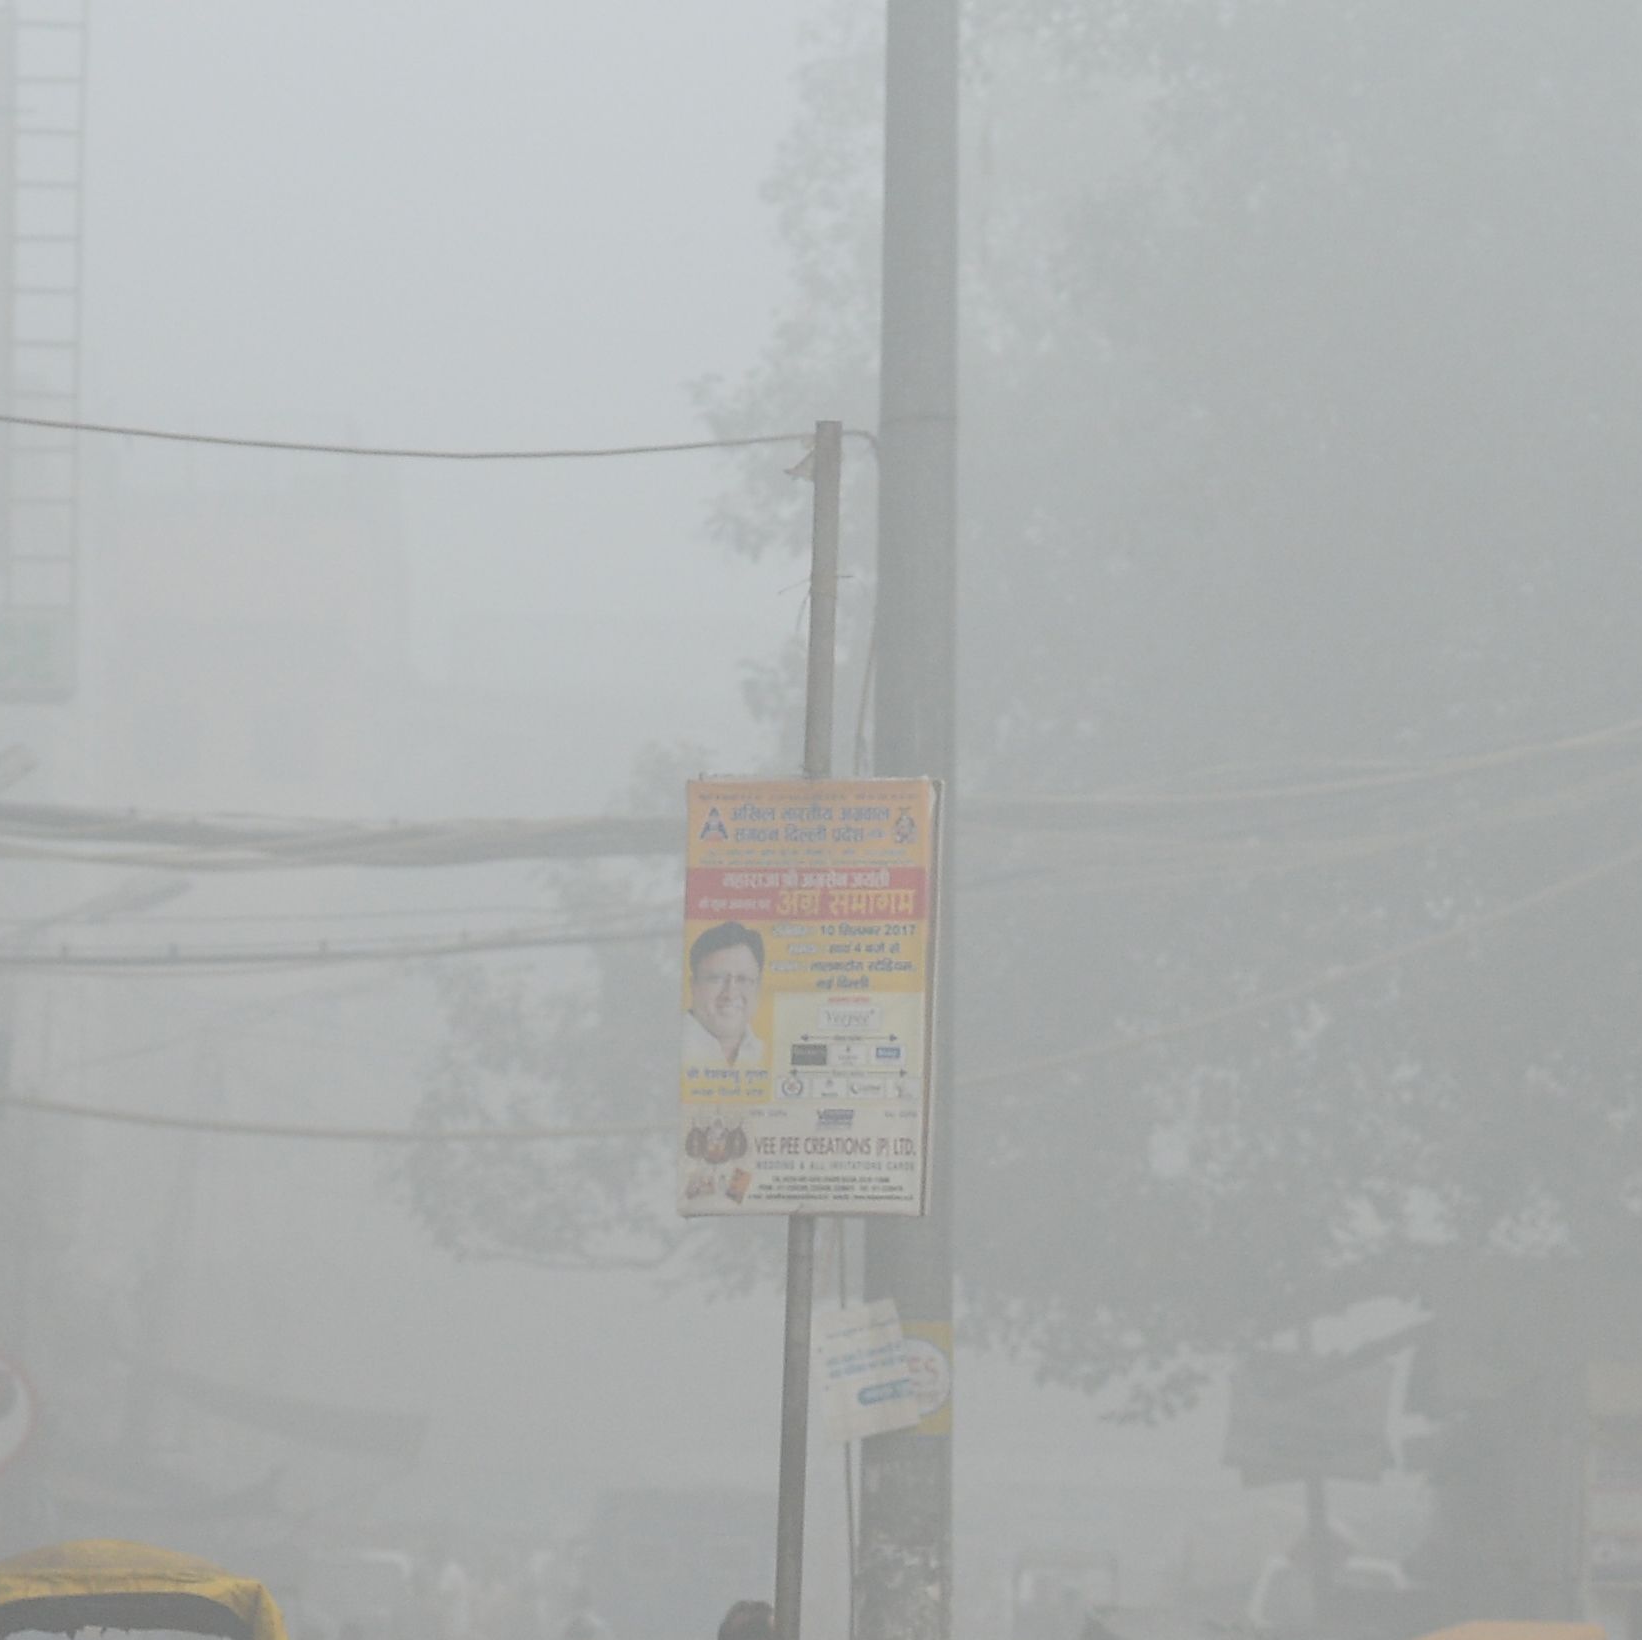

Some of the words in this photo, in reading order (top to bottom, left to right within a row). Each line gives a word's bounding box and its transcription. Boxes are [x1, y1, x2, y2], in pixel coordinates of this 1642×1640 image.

[821, 924, 835, 936] 10
[884, 923, 916, 936] 2017
[754, 1136, 777, 1155] VEE
[779, 1136, 800, 1155] PEE
[804, 1136, 872, 1156] CREATIONS
